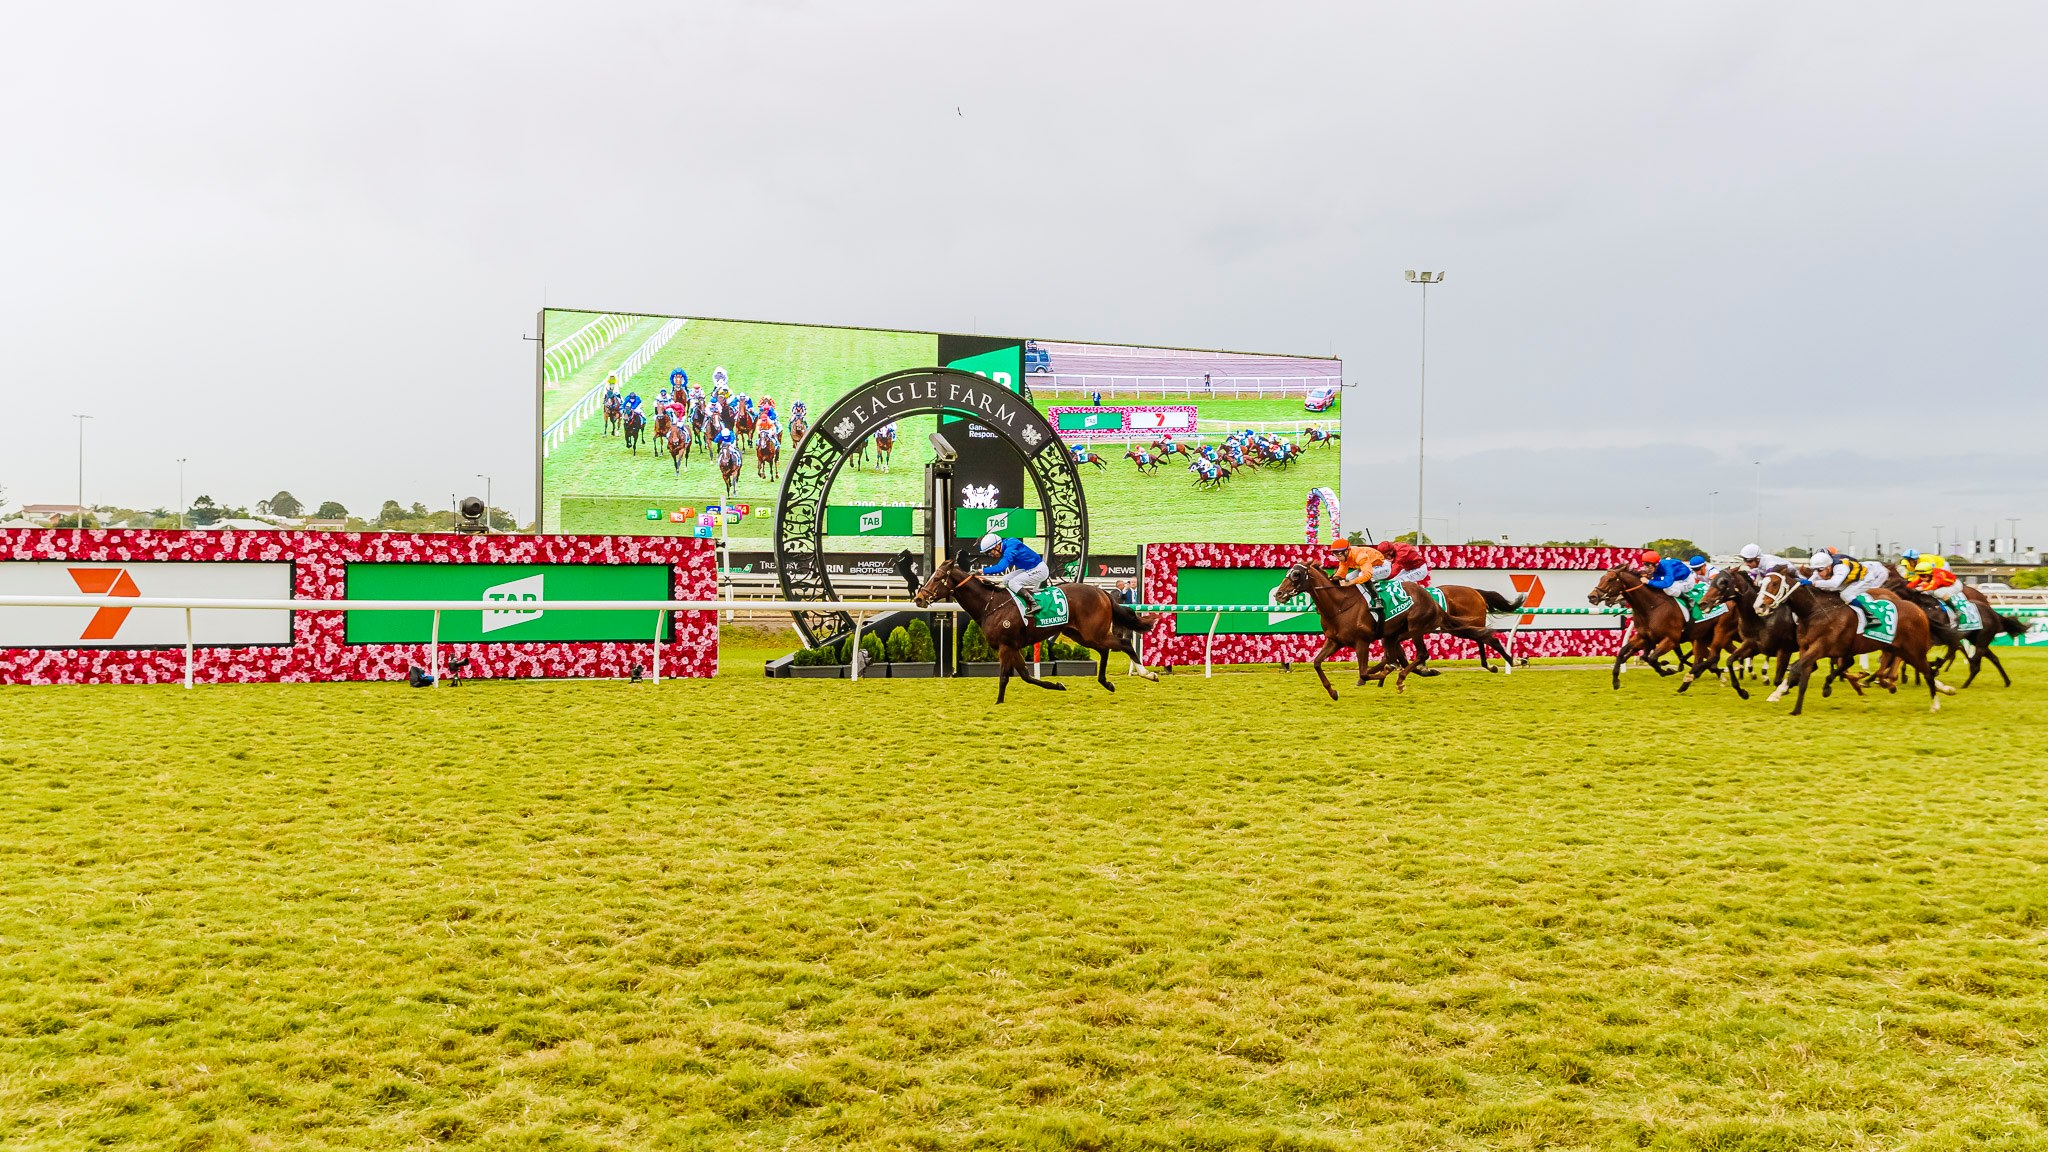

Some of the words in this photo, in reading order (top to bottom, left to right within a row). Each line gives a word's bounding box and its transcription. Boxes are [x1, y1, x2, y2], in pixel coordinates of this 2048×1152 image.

[851, 381, 938, 425] EAGLE
[949, 383, 1016, 427] FARM
[862, 517, 880, 526] TAB
[989, 519, 1006, 528] TAB
[700, 528, 707, 537] 9
[1053, 588, 1067, 616] 5
